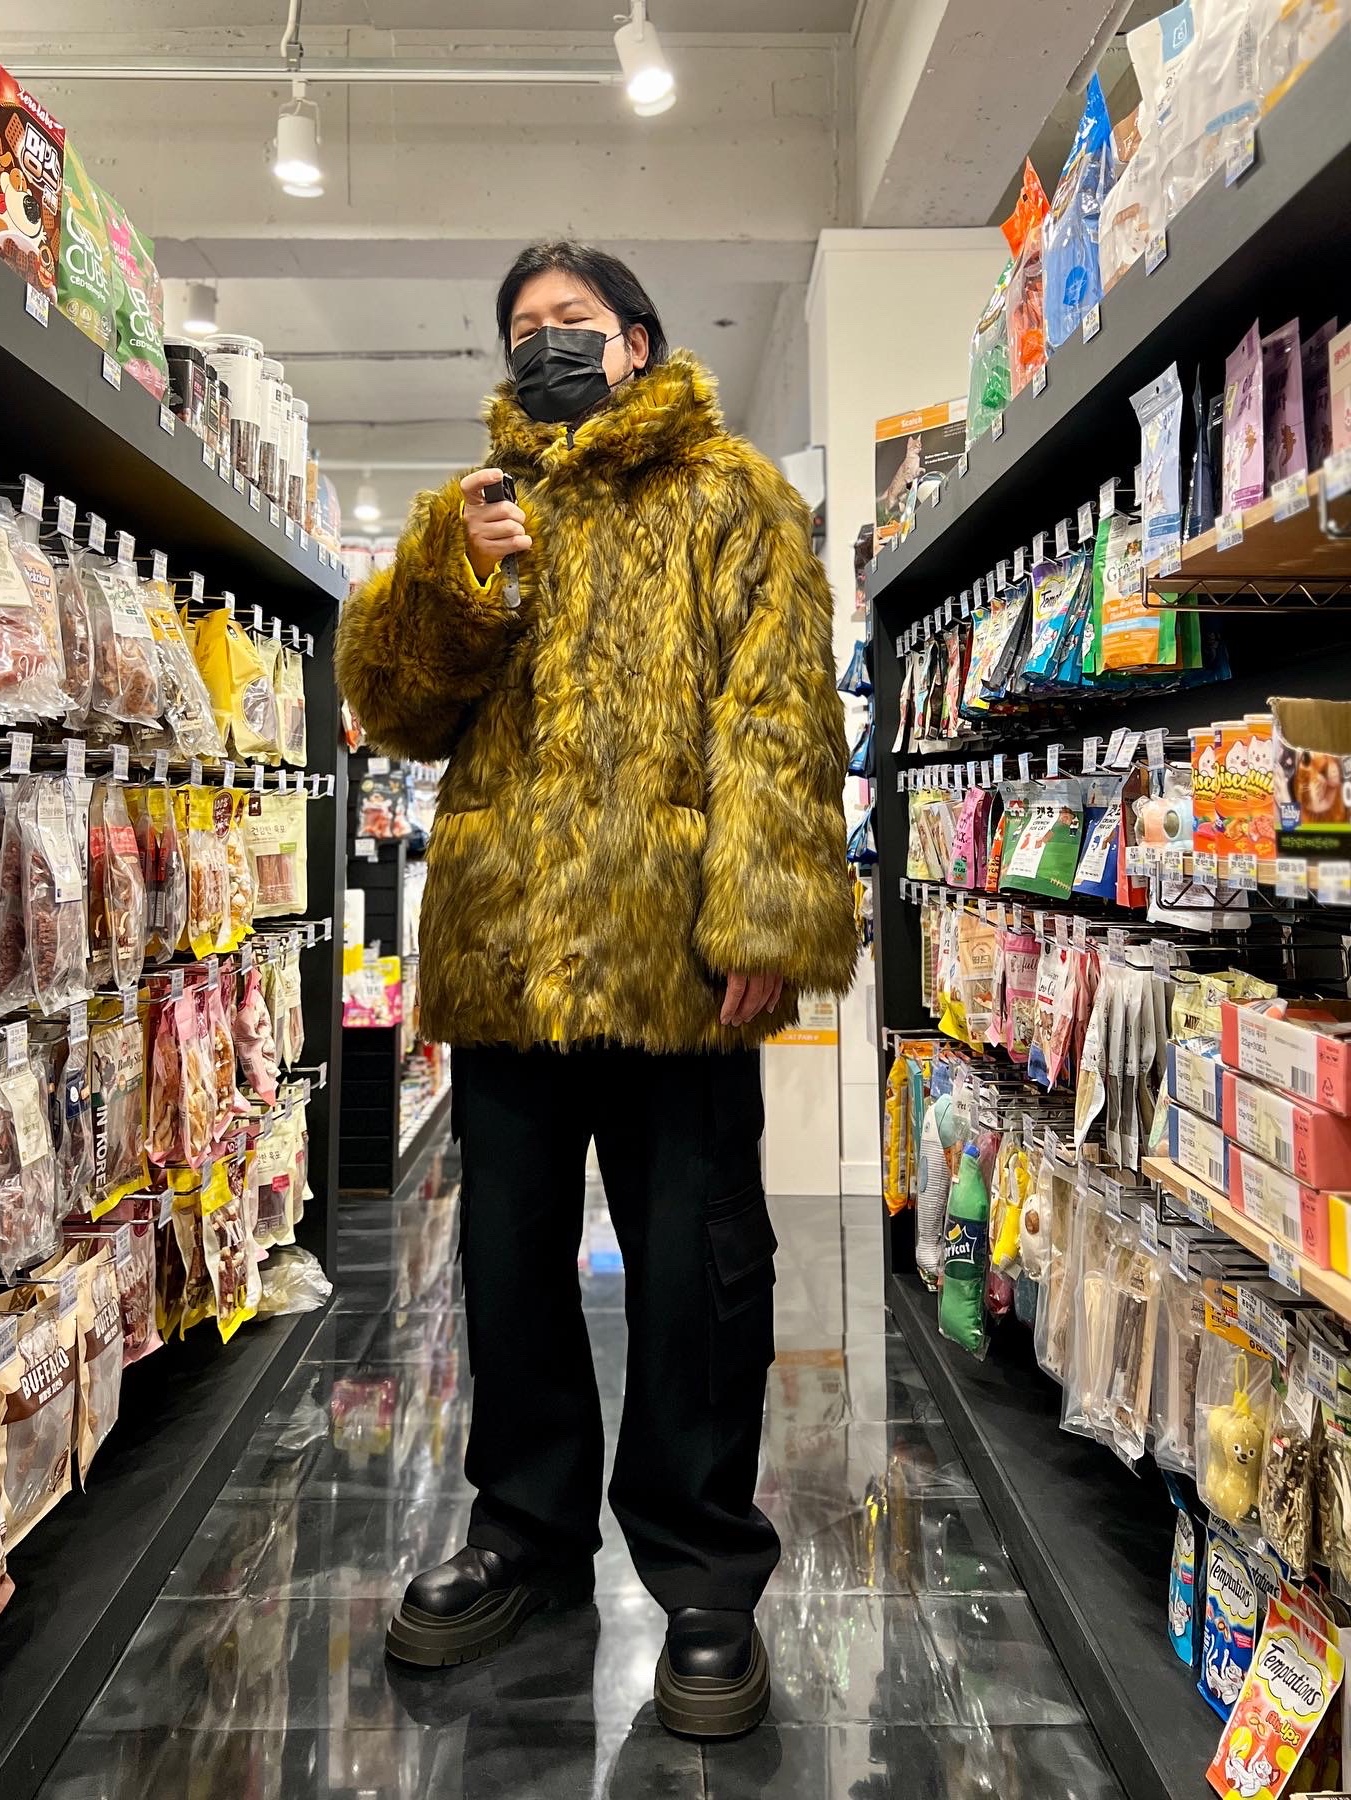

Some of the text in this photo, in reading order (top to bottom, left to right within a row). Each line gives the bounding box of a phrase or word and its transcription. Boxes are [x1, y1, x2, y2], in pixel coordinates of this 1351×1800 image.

[96, 1131, 108, 1191] KORE
[94, 1296, 120, 1340] BUFFALO
[20, 1347, 70, 1401] BUFFALO
[1209, 1552, 1252, 1608] Temptations
[1263, 1643, 1322, 1706] Temptations
